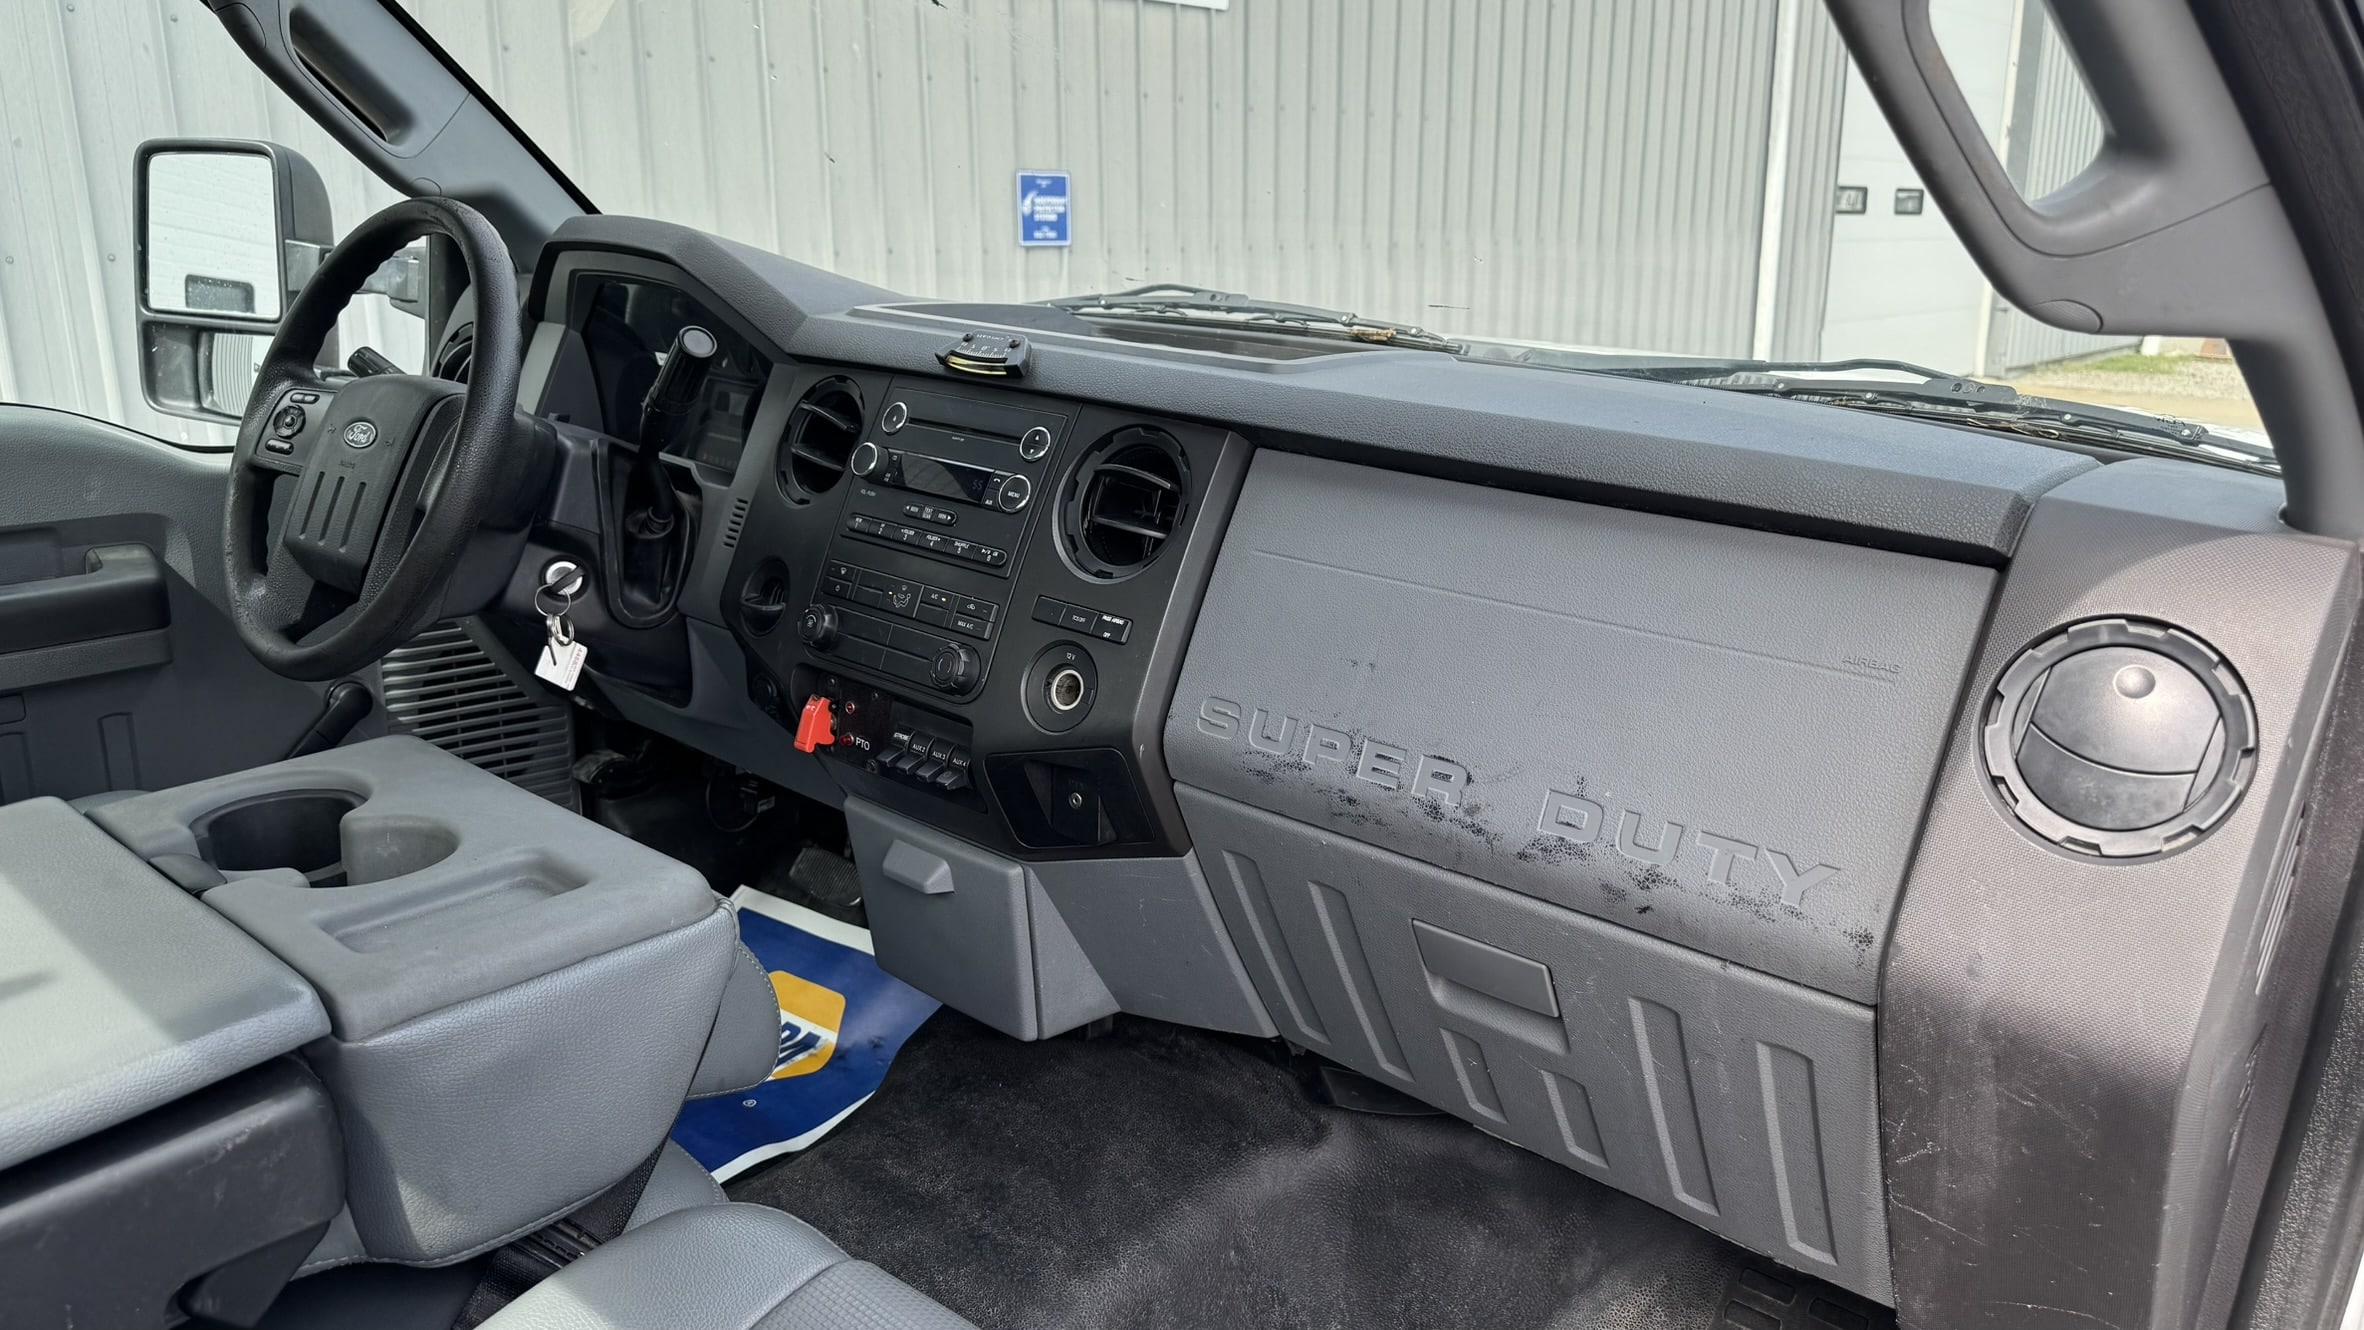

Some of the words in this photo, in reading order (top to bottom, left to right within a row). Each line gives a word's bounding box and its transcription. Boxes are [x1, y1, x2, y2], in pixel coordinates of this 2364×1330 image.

[347, 424, 373, 444] Ford
[1007, 490, 1021, 499] MENU
[1841, 655, 1901, 674] AIRBAG
[856, 737, 871, 751] PTO
[912, 743, 922, 752] AUX
[932, 751, 942, 759] AUX
[952, 758, 963, 766] AUX
[1196, 696, 1472, 808] SUPER
[1536, 787, 1841, 907] DUTY
